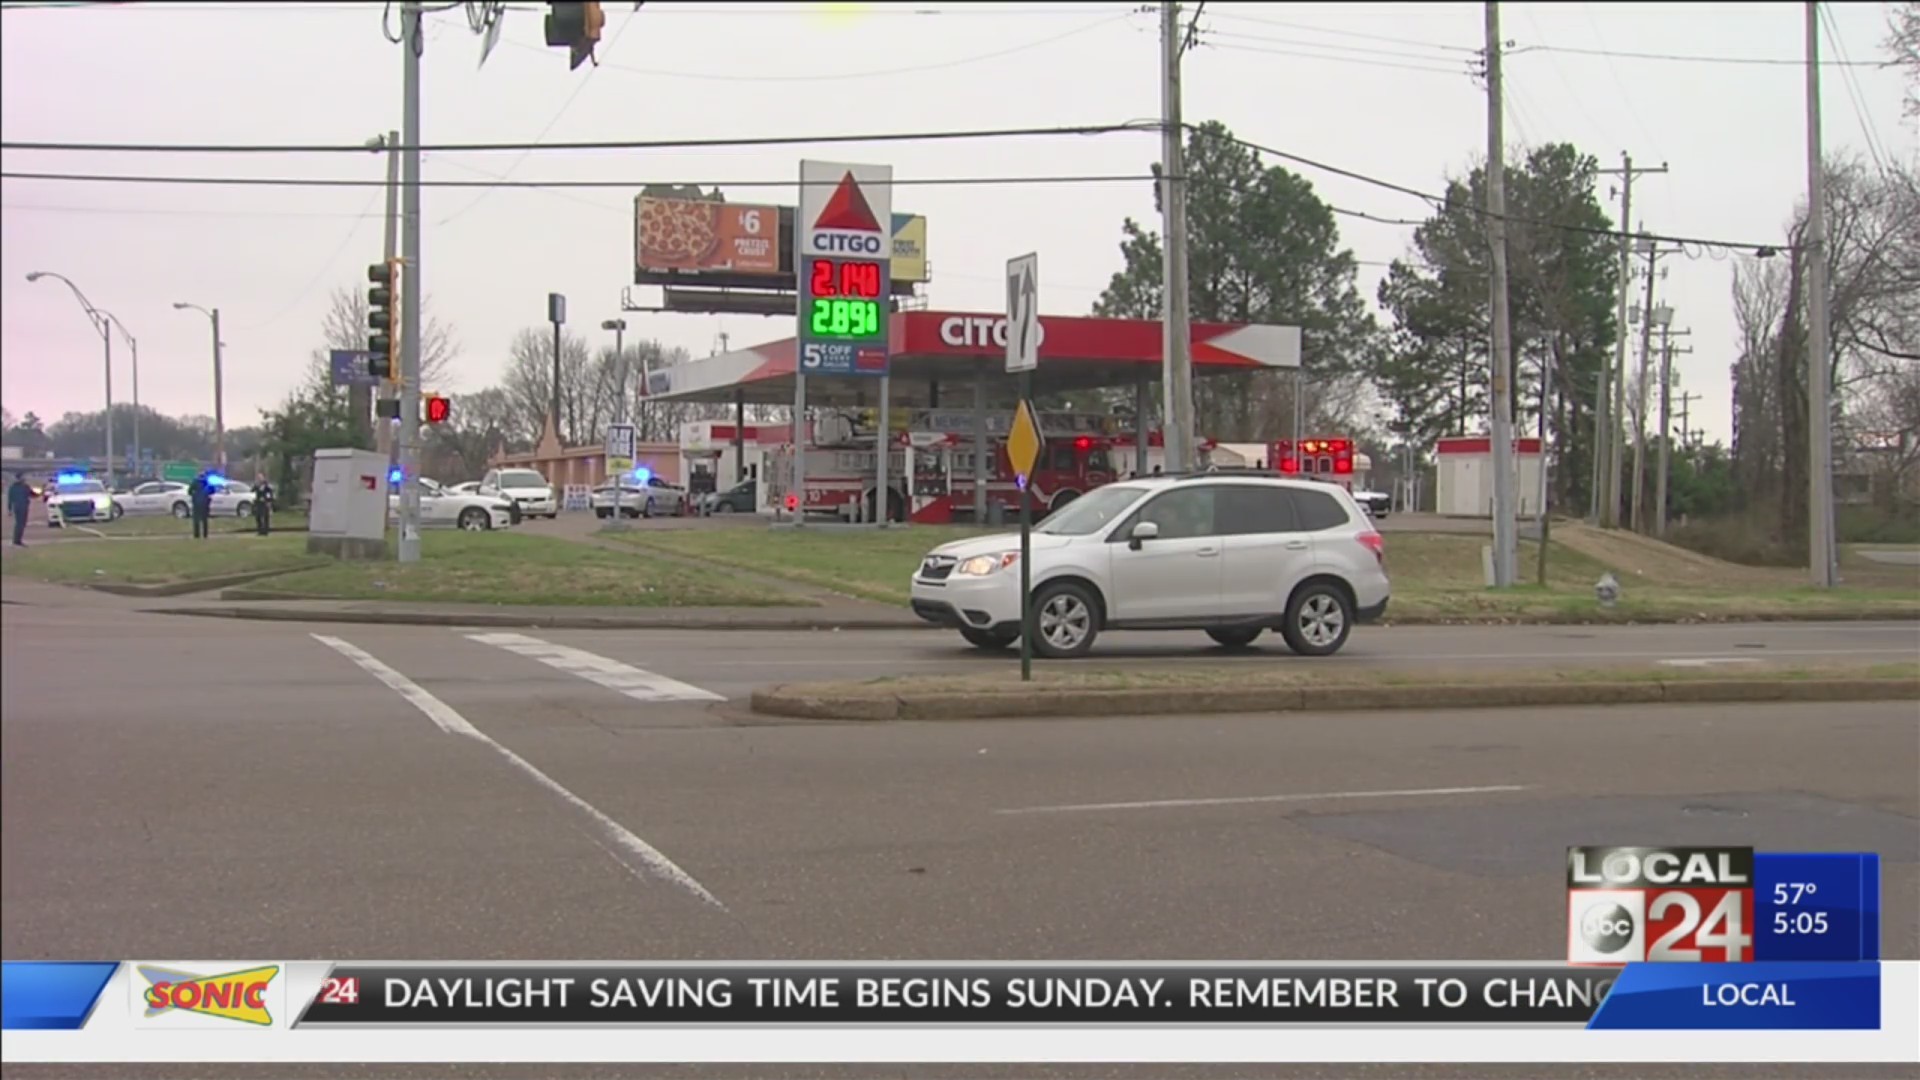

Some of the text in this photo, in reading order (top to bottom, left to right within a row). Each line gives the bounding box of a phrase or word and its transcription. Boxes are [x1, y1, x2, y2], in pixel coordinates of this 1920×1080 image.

[739, 208, 762, 234] $6
[738, 246, 767, 257] CRUST
[813, 232, 881, 255] CITGO
[941, 316, 1045, 348] CITG
[828, 345, 852, 355] OFF
